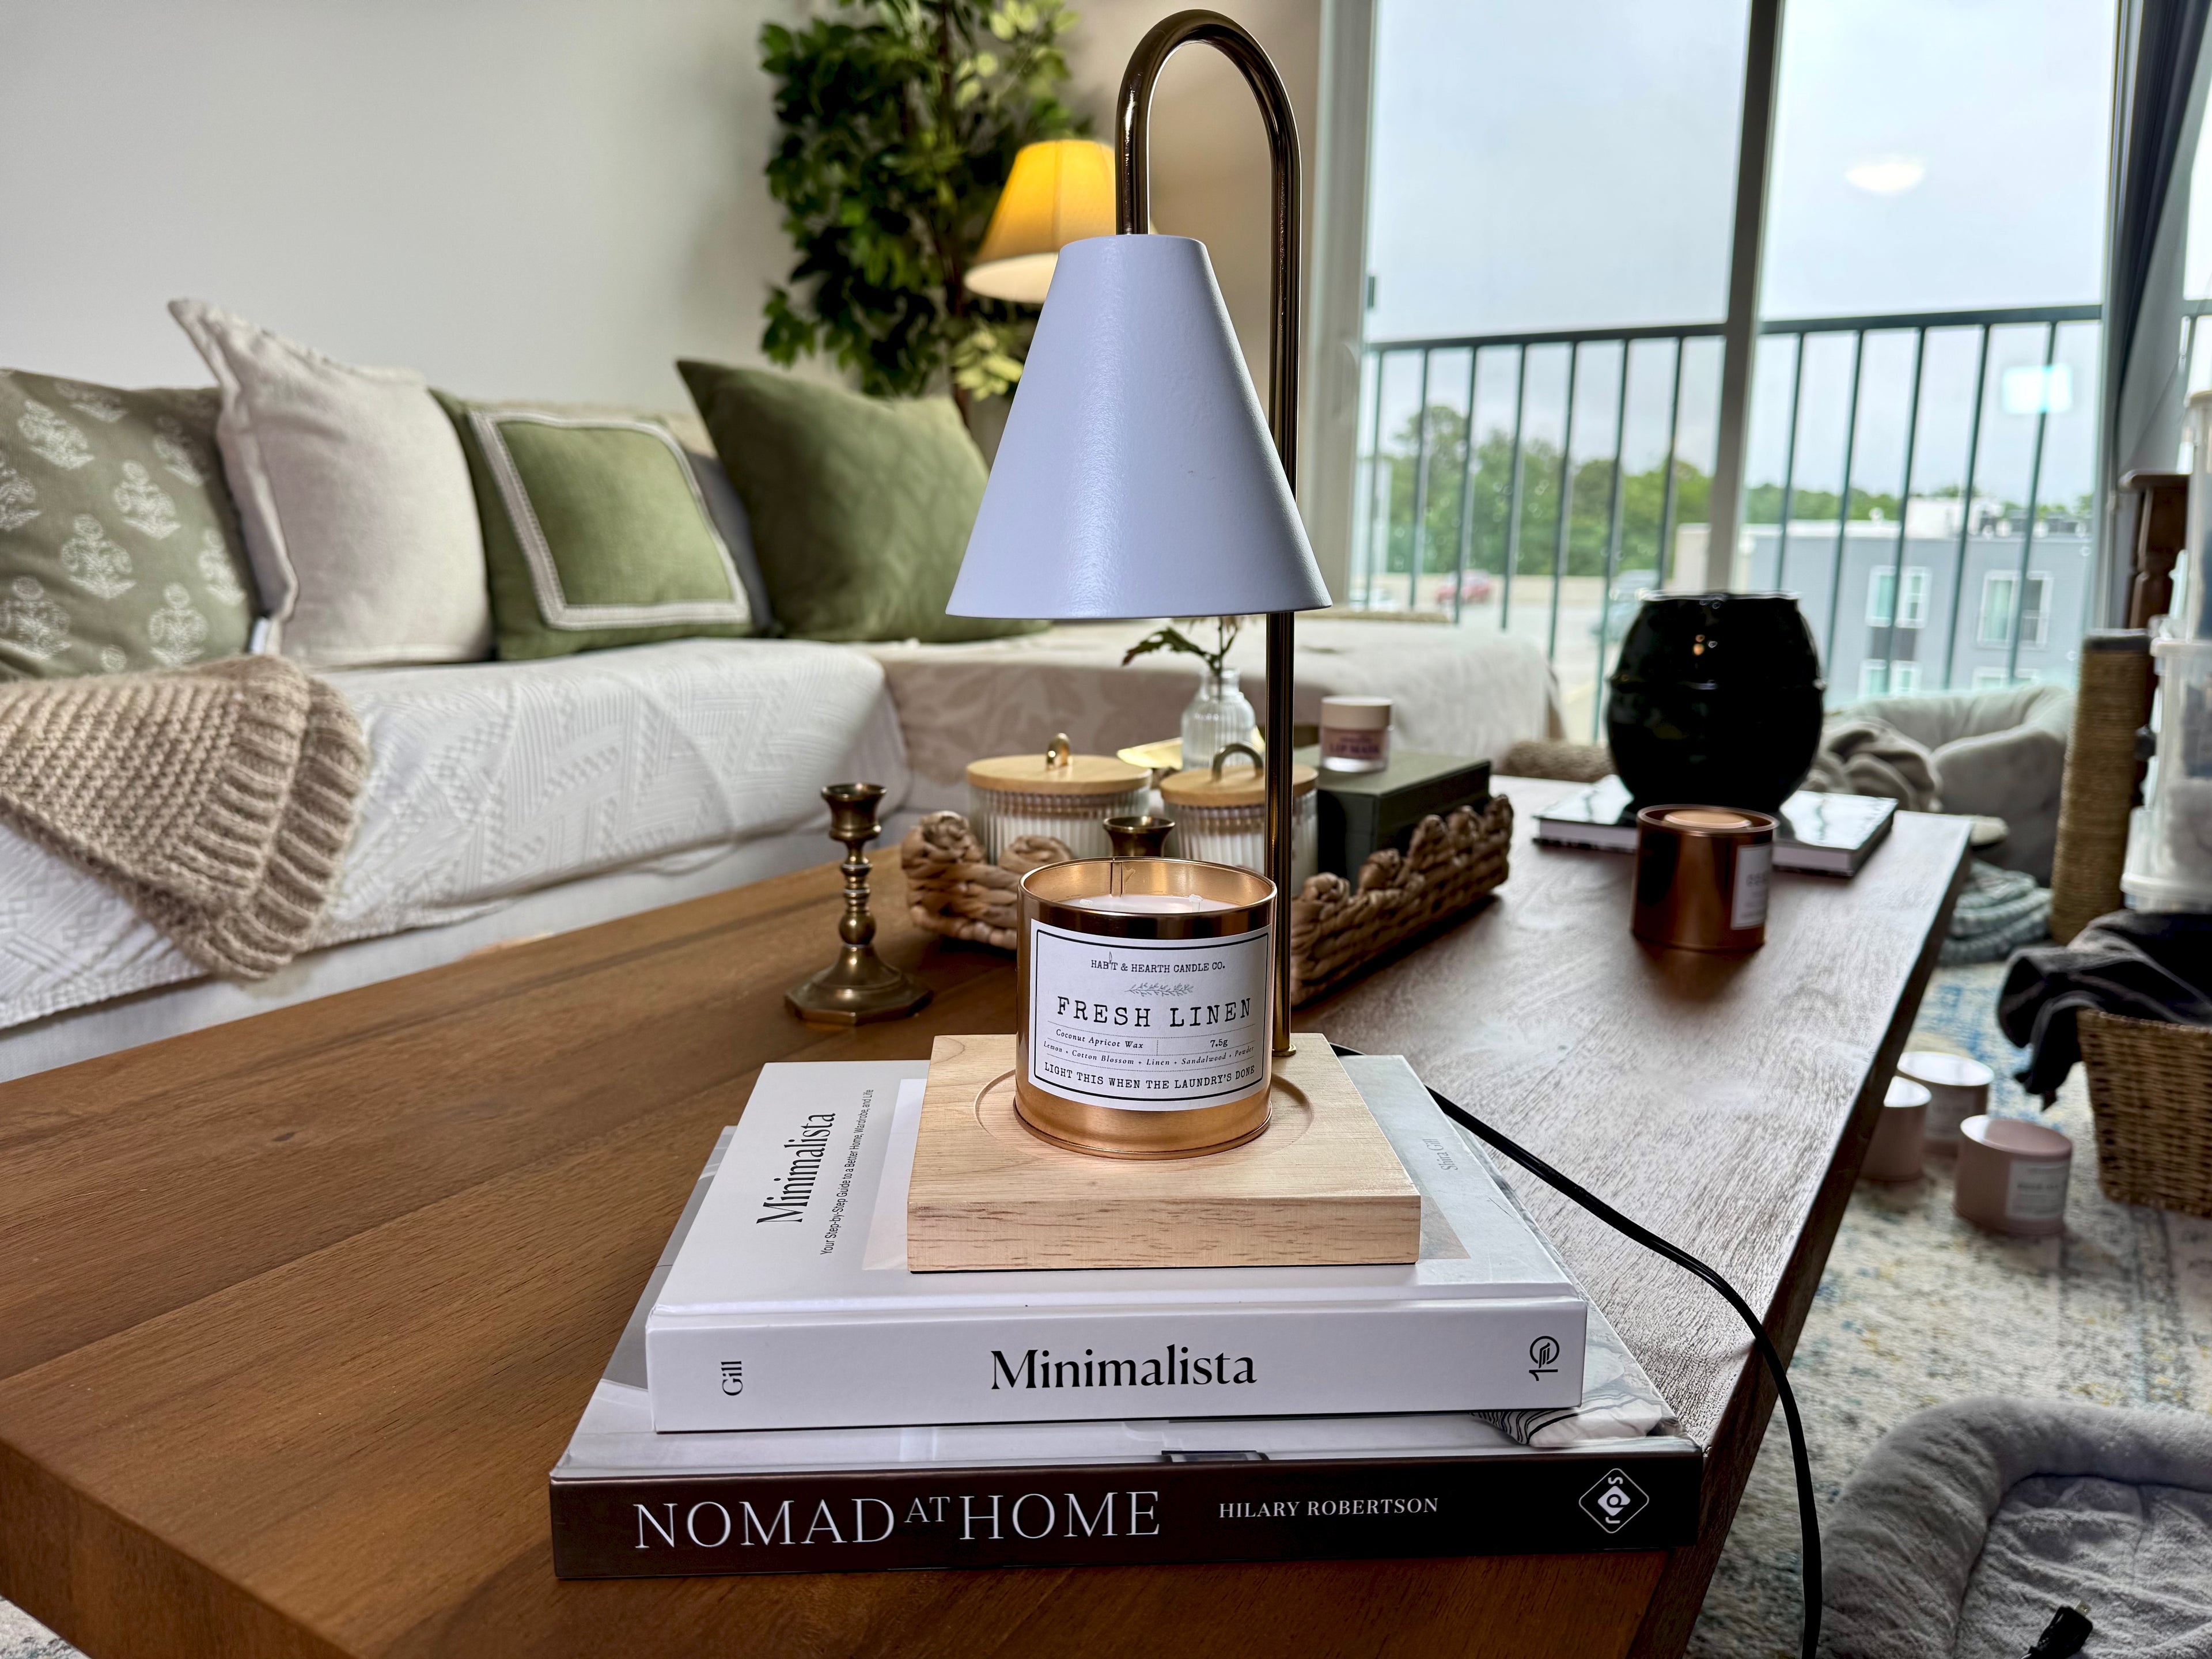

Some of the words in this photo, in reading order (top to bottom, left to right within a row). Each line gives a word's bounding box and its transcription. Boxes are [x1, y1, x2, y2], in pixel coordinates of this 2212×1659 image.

[1121, 963, 1128, 971] &
[1131, 964, 1170, 973] HEARTH
[1173, 963, 1209, 973] CANDLE
[1212, 961, 1225, 971] CO.
[1057, 995, 1152, 1028] FRESH
[1169, 997, 1251, 1027] LINEN
[1056, 1029, 1085, 1042] Coconut
[1088, 1037, 1120, 1047] Apricot
[1210, 1039, 1228, 1048] 7.5g
[1044, 1041, 1062, 1052] Lemon
[1072, 1050, 1097, 1060] Cotton
[1101, 1055, 1134, 1065] Blossom
[1181, 1052, 1226, 1065] Sandalwood
[1234, 1046, 1254, 1057] Powder
[1044, 1062, 1073, 1078] LIGHT
[1077, 1072, 1104, 1085] THIS
[1109, 1077, 1140, 1089] WHEN
[1146, 1080, 1169, 1089] THE
[1175, 1073, 1232, 1089] LAUNDRY'S
[1236, 1065, 1255, 1080] DONE
[863, 1089, 874, 1098] Life
[862, 1099, 871, 1108] and
[853, 1108, 871, 1133] Wardrobe,
[849, 1134, 864, 1150] Home,
[1422, 1139, 1444, 1151] Gill
[844, 1150, 858, 1167] Better
[1437, 1152, 1458, 1170] Shira
[756, 1112, 836, 1224] Minimalista
[836, 1180, 851, 1197] Guide
[824, 1198, 849, 1238] Step-by-Step
[820, 1240, 835, 1255] Your
[990, 1344, 1258, 1390] Minimalista
[721, 1359, 744, 1396] Gill
[1219, 1501, 1300, 1519] HILARY
[1306, 1497, 1440, 1517] ROBERTSON
[633, 1497, 895, 1550] NOMAD
[904, 1496, 950, 1524] AT
[959, 1490, 1160, 1541] HOME
